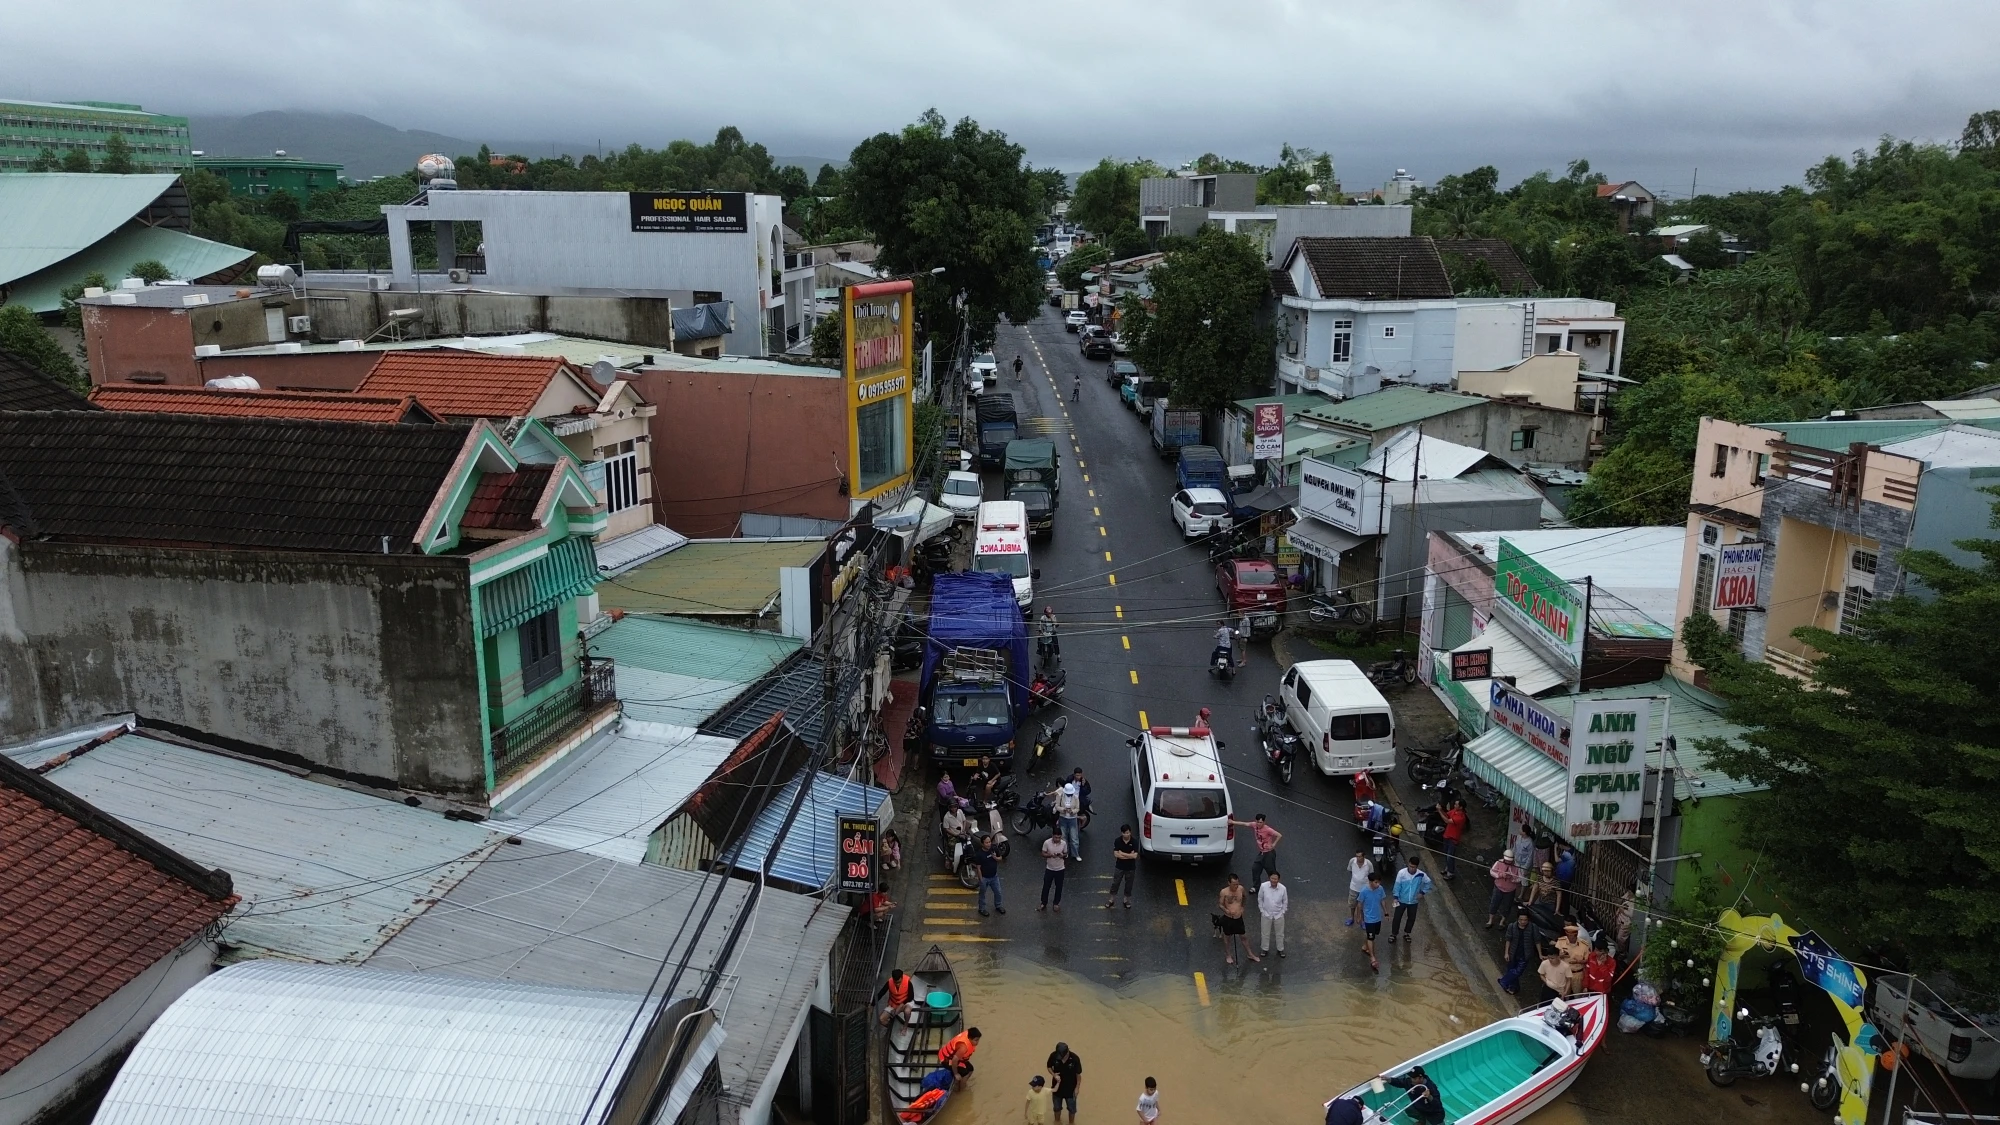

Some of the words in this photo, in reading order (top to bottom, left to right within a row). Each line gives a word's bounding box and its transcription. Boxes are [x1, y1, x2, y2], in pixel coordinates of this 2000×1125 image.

[653, 198, 687, 212] NGỌC
[854, 303, 869, 318] Thời
[870, 302, 888, 318] Trang
[1330, 482, 1344, 496] ANH
[1717, 574, 1756, 607] KHOA
[1529, 591, 1569, 641] XANH
[1454, 655, 1469, 667] NHA
[1469, 653, 1488, 666] KHOA
[1466, 666, 1487, 677] KHOA
[1493, 709, 1508, 727] TRÁM
[1505, 693, 1525, 719] NHA
[1527, 707, 1557, 739] KHOA
[1588, 712, 1637, 733] ANH
[1585, 739, 1635, 764] NGỮ
[1573, 771, 1640, 793] SPEAK
[1590, 801, 1620, 821] UP
[1795, 941, 1825, 971] LET'S
[1825, 963, 1860, 997] SHINE
